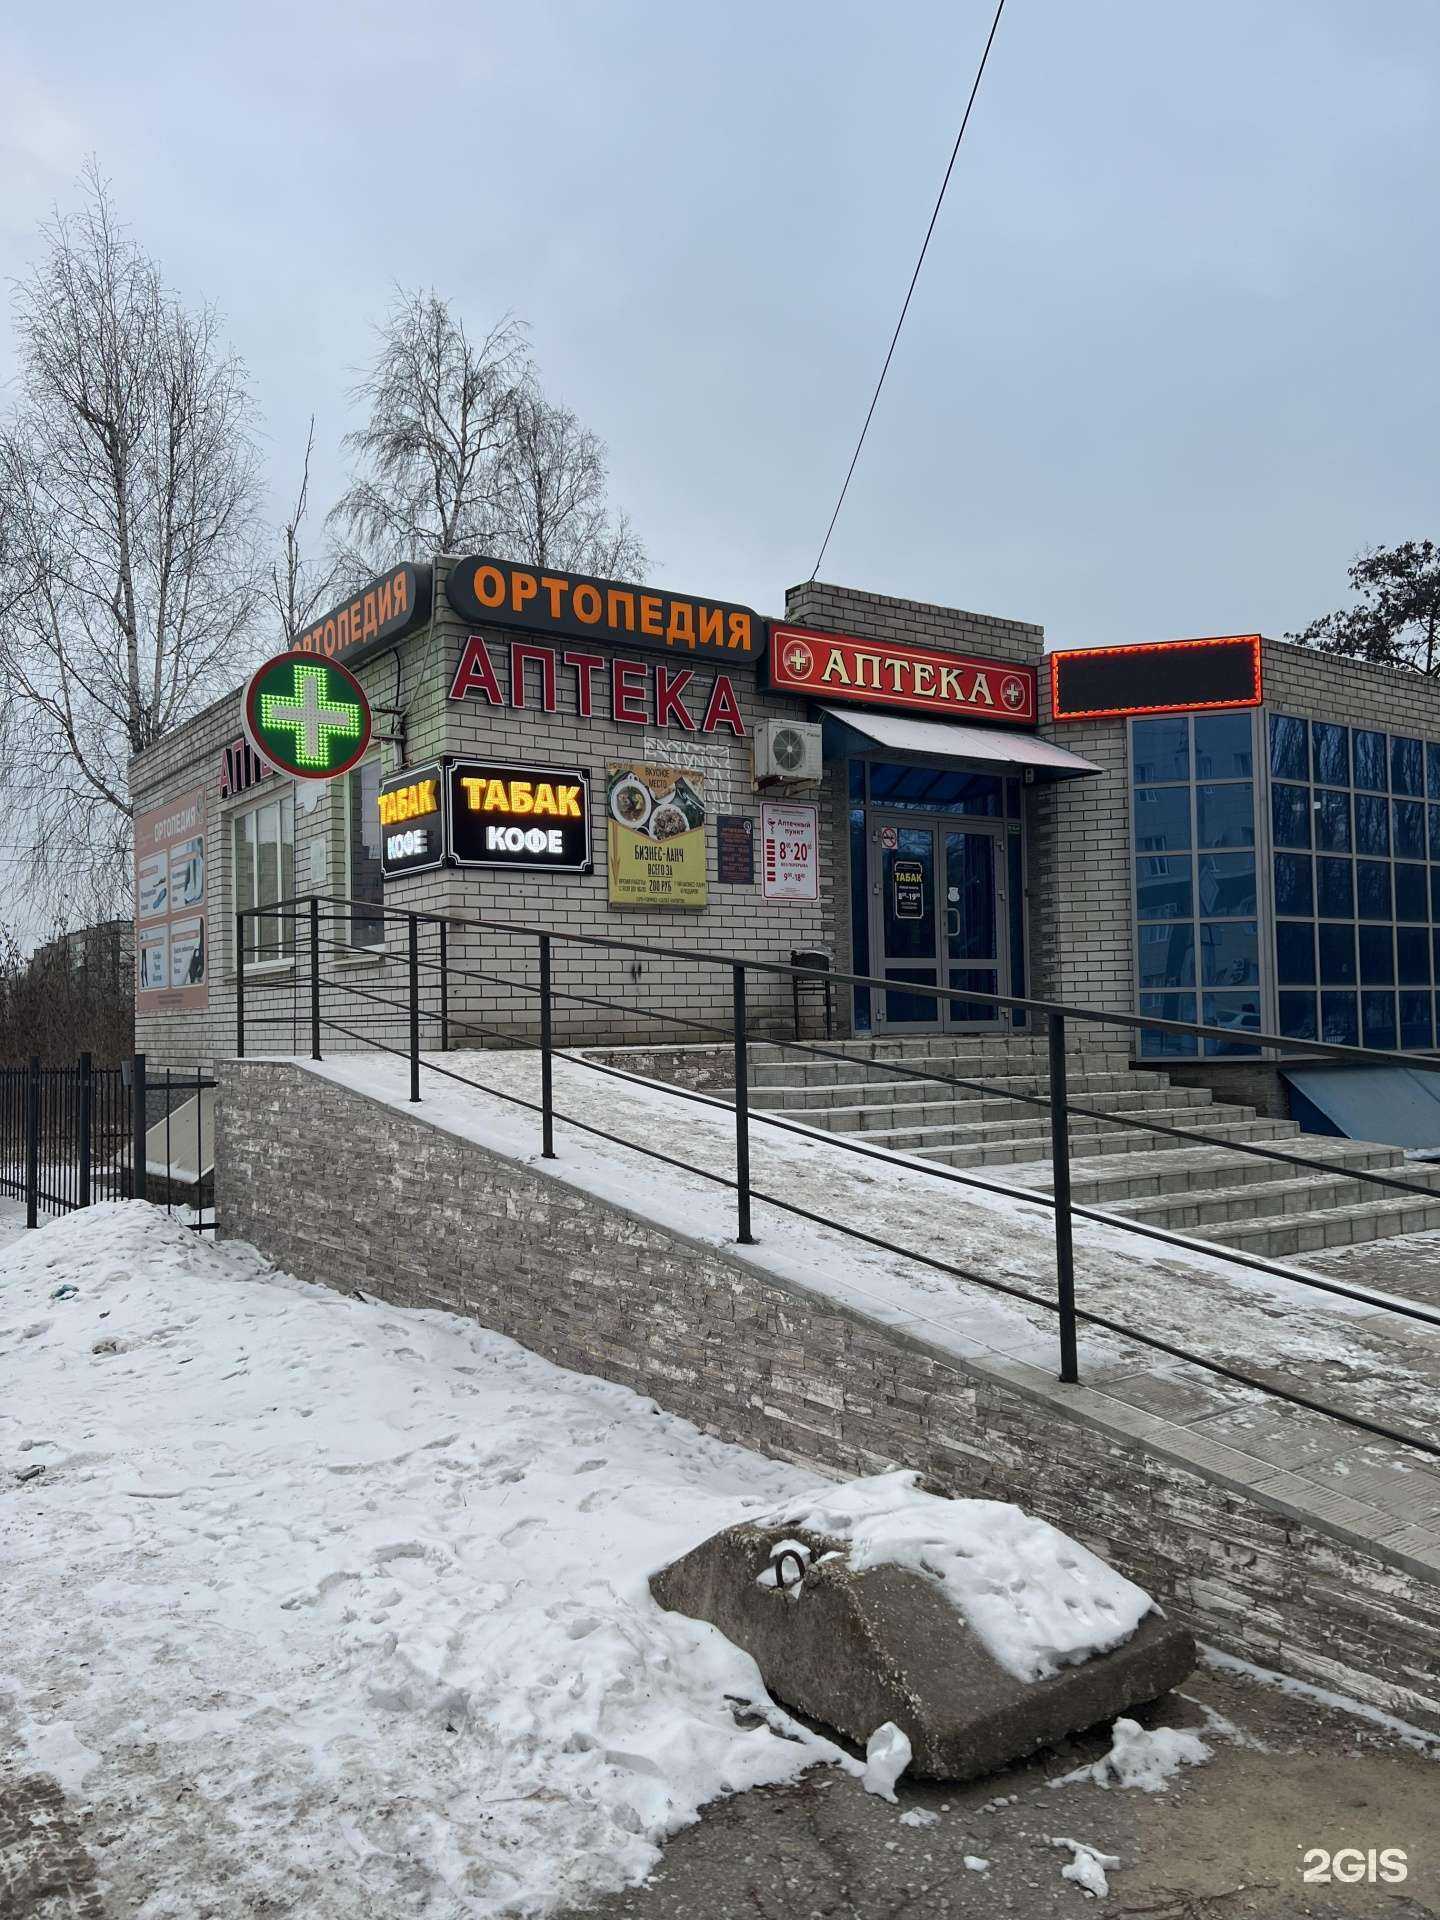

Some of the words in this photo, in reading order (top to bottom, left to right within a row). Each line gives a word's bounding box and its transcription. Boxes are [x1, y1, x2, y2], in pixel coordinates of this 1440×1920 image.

[292, 570, 408, 657] РТОПЕДИЯ
[473, 565, 752, 651] ОРТОПЕДИЯ
[449, 635, 747, 737] АПТЕКА
[821, 649, 995, 705] АПТЕКА
[378, 779, 438, 825] ТАБАК
[462, 777, 582, 817] ТАБАК
[486, 825, 563, 853] КОФЕ
[778, 820, 811, 828] Аптечный
[388, 829, 427, 860] КОФЕ
[634, 844, 684, 862] БИЗНЕС-ЛАНЧ
[895, 872, 922, 882] ТАБАК
